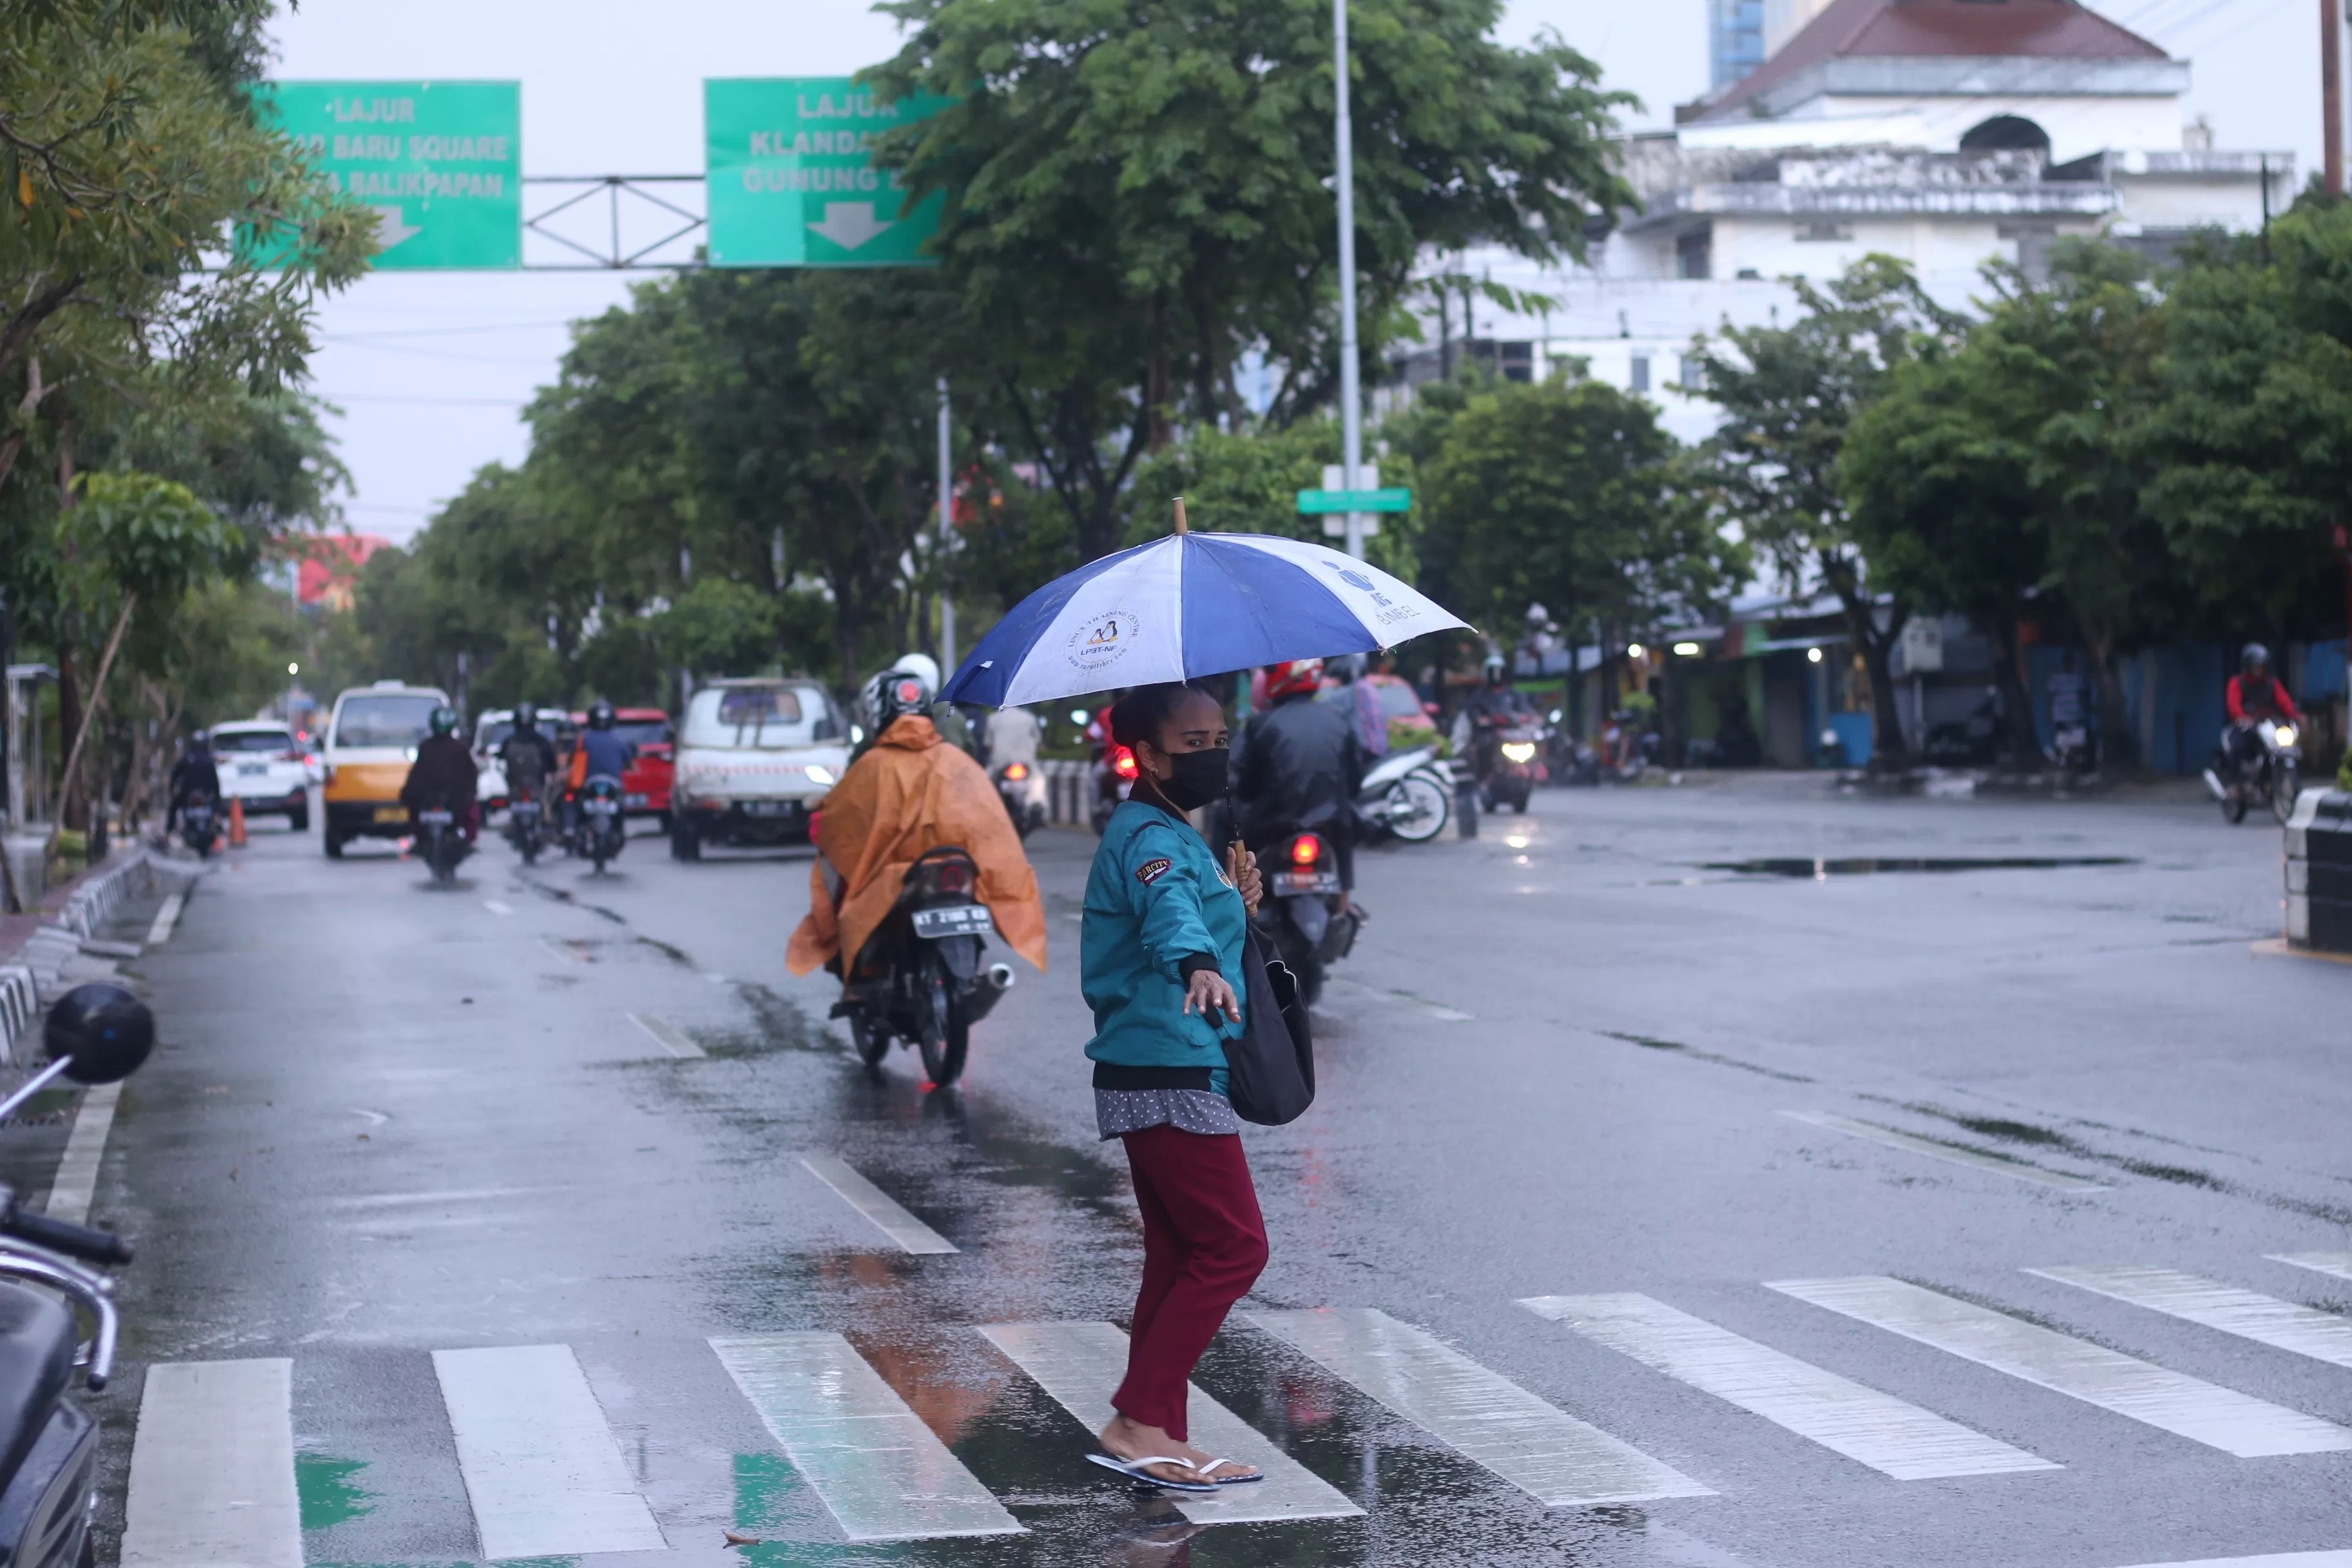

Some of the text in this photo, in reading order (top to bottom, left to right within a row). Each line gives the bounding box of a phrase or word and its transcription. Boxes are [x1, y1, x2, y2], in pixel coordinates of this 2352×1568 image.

[333, 98, 415, 122] LAJUR
[333, 135, 400, 160] BARU
[408, 135, 508, 161] SQUARE
[348, 172, 503, 198] BALIKPAPAN
[743, 167, 878, 192] GUNUNG
[1377, 605, 1420, 625] BIMBEL
[1068, 625, 1086, 647] LINUX
[1087, 610, 1128, 625] TRAINING
